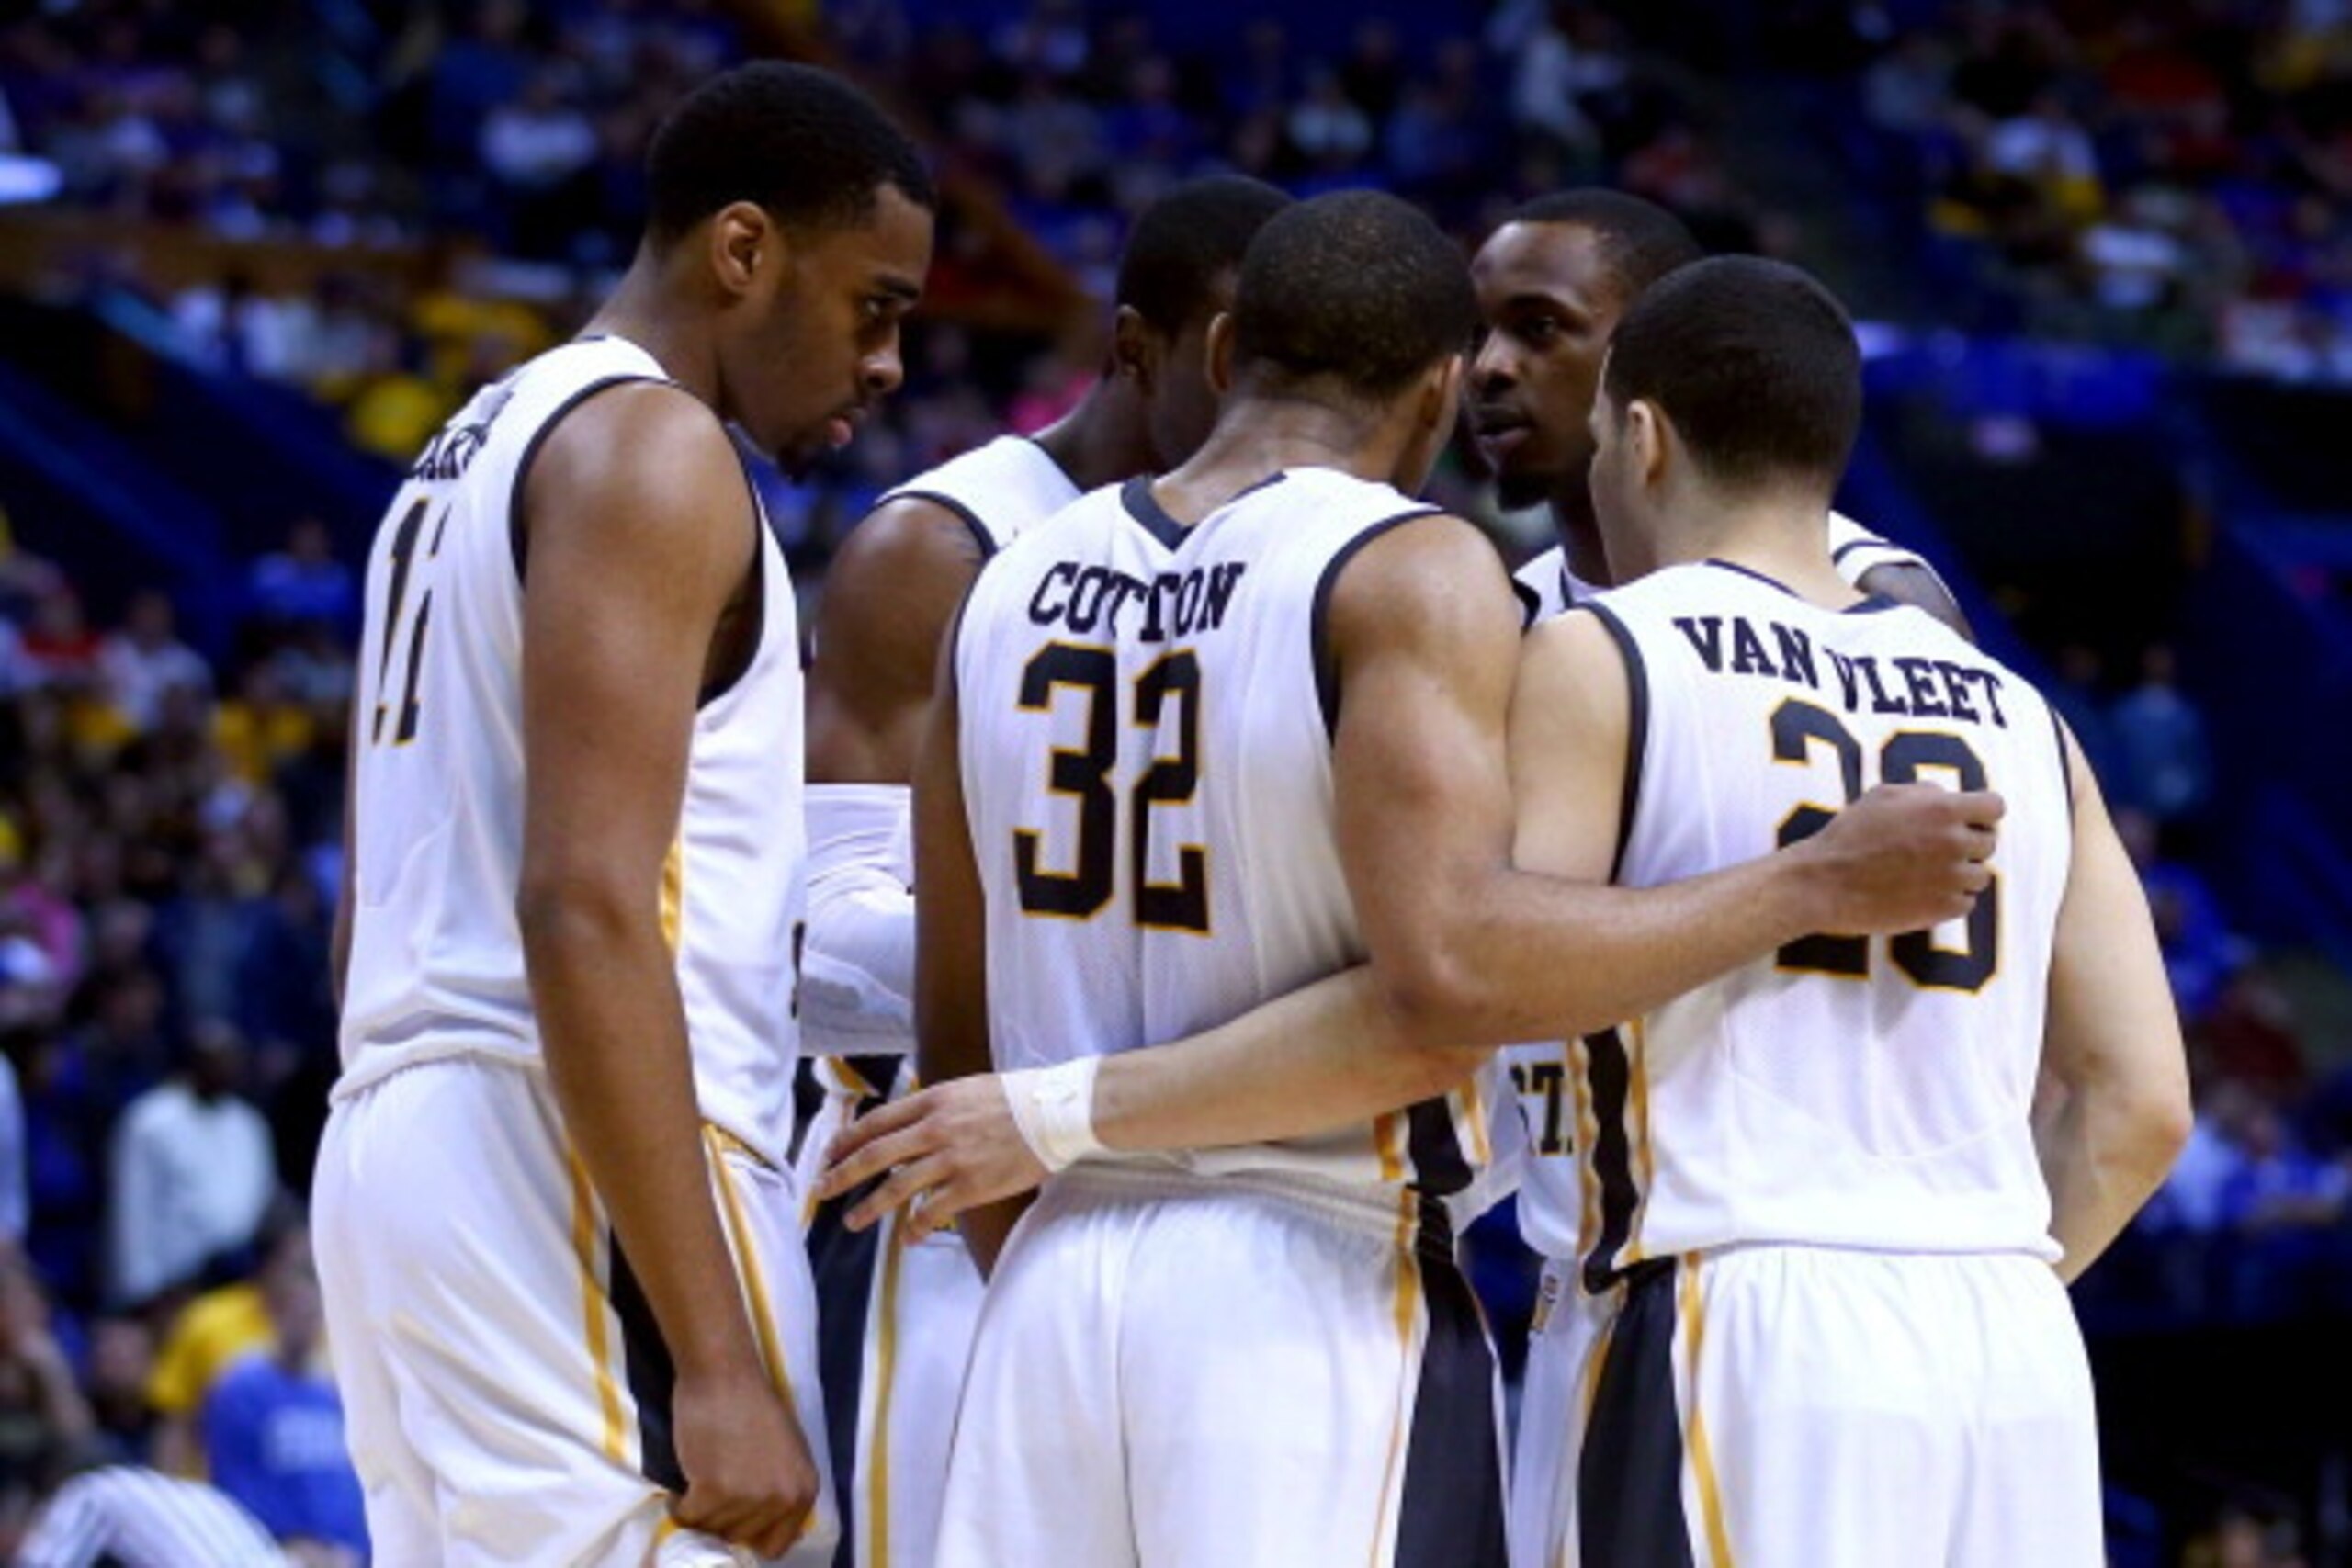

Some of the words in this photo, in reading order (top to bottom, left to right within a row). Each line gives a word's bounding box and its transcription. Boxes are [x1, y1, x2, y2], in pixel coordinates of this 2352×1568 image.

[1028, 562, 1247, 642] COTTON
[1672, 616, 1820, 690] VAN
[1823, 646, 2007, 728] VLEET
[1012, 638, 1213, 937] 32
